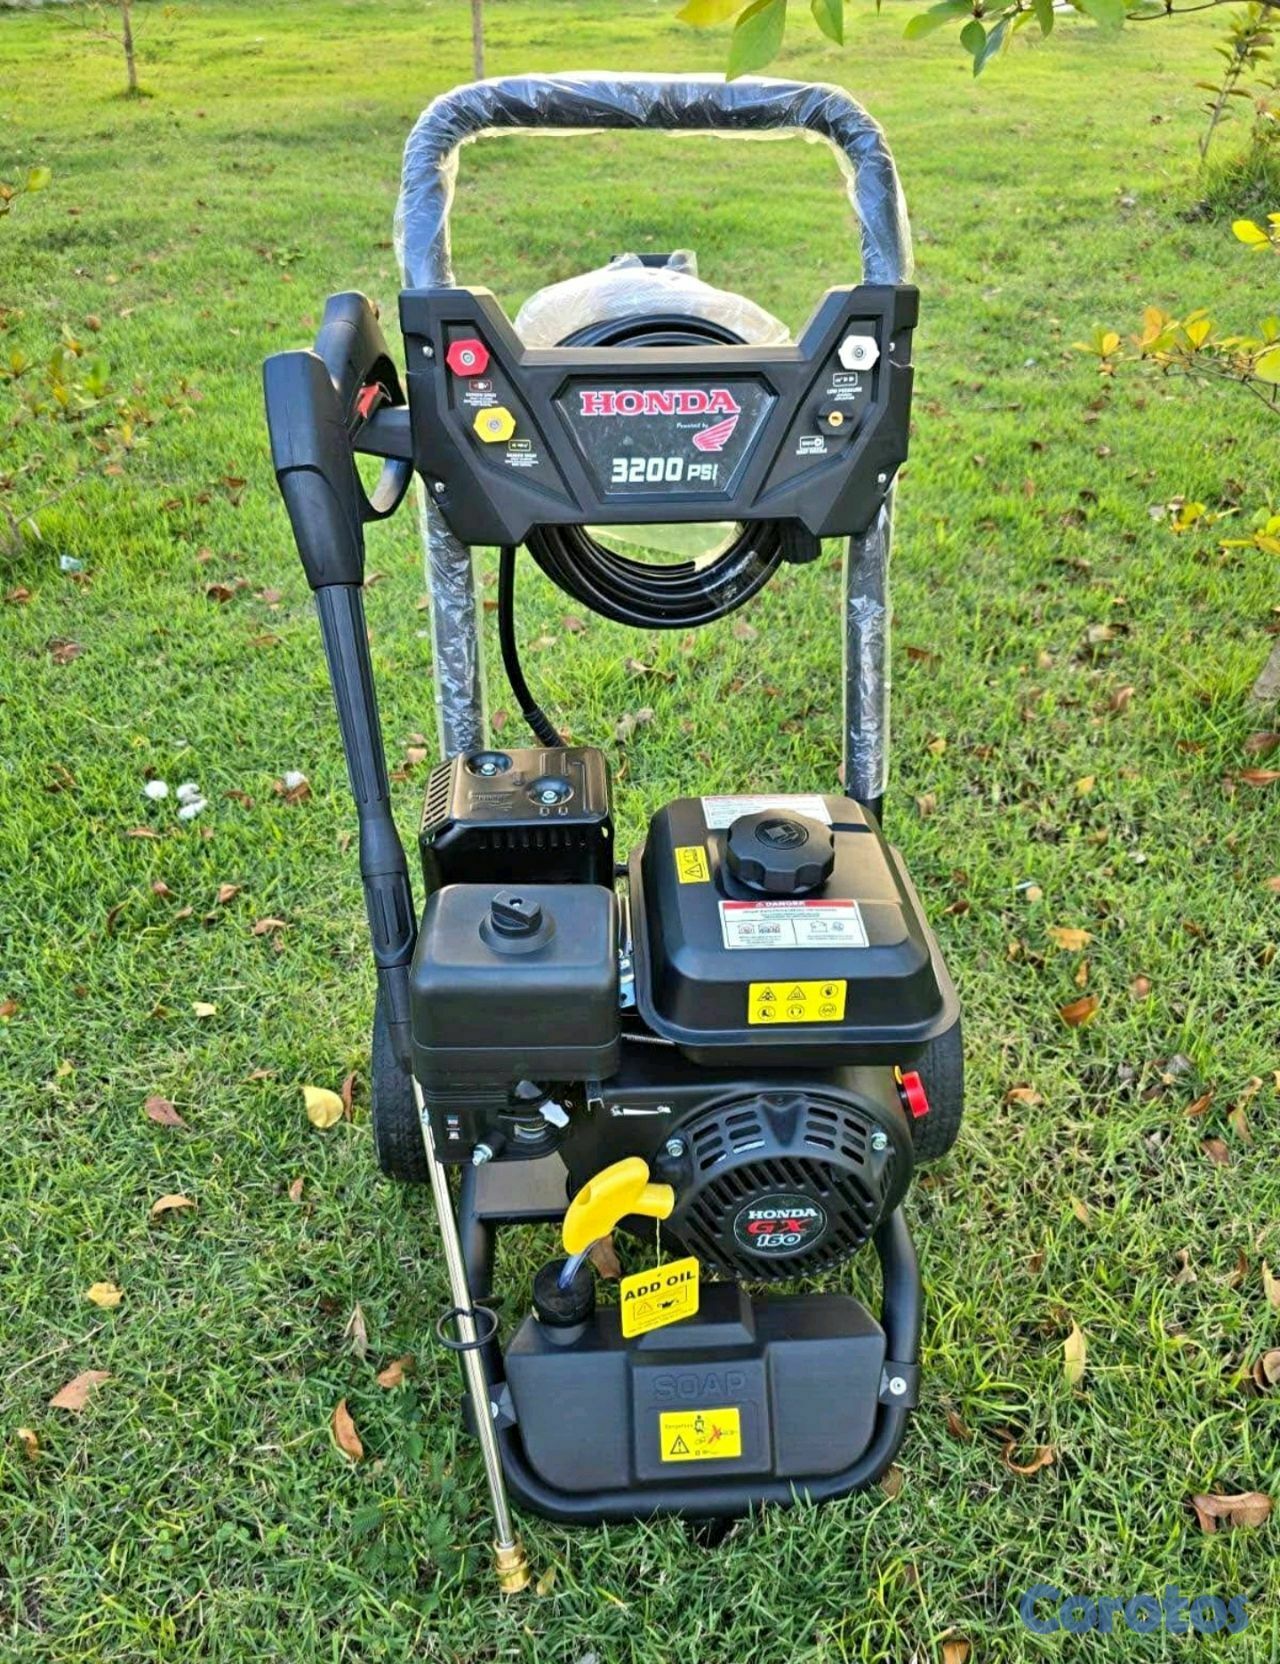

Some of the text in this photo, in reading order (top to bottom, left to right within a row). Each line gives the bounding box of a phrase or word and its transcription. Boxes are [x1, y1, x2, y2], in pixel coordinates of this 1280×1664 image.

[580, 389, 741, 416] HONDA
[611, 457, 718, 483] 3200 PSI
[747, 1218, 813, 1233] GX
[748, 1207, 818, 1219] HONDA
[756, 1232, 801, 1247] 160
[624, 1269, 696, 1302] ADD OIL
[653, 1370, 747, 1400] SOAP
